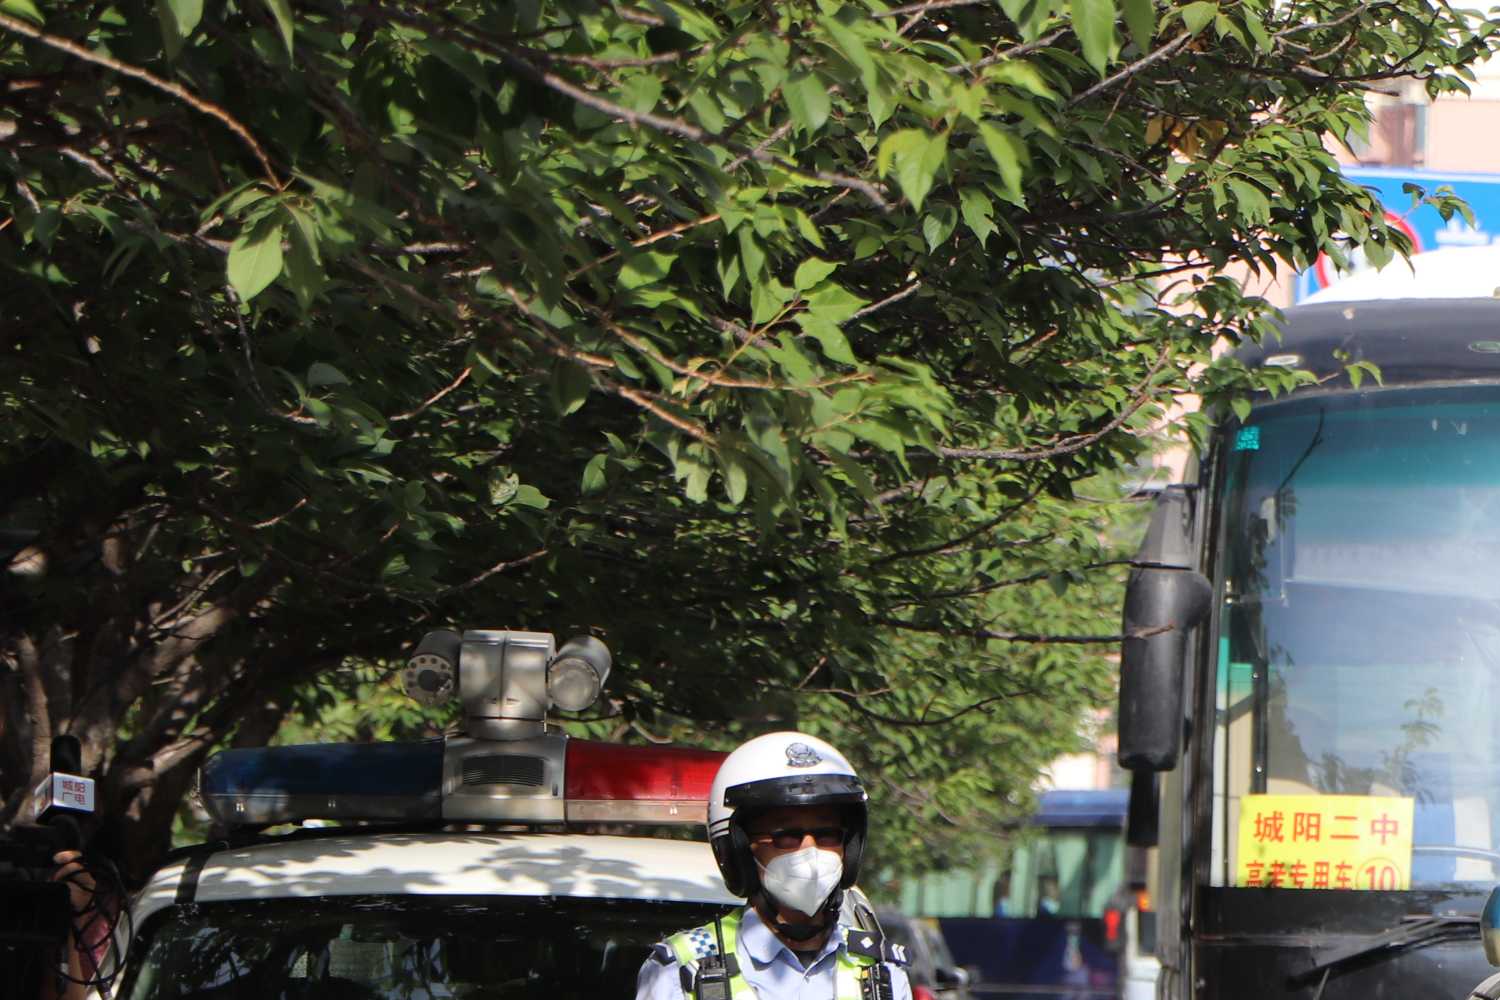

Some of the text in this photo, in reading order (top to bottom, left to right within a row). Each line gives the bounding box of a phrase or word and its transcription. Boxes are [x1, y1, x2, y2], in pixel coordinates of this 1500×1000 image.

[1252, 810, 1400, 845] 城阳二中
[1245, 858, 1397, 890] 高考专用车 10
